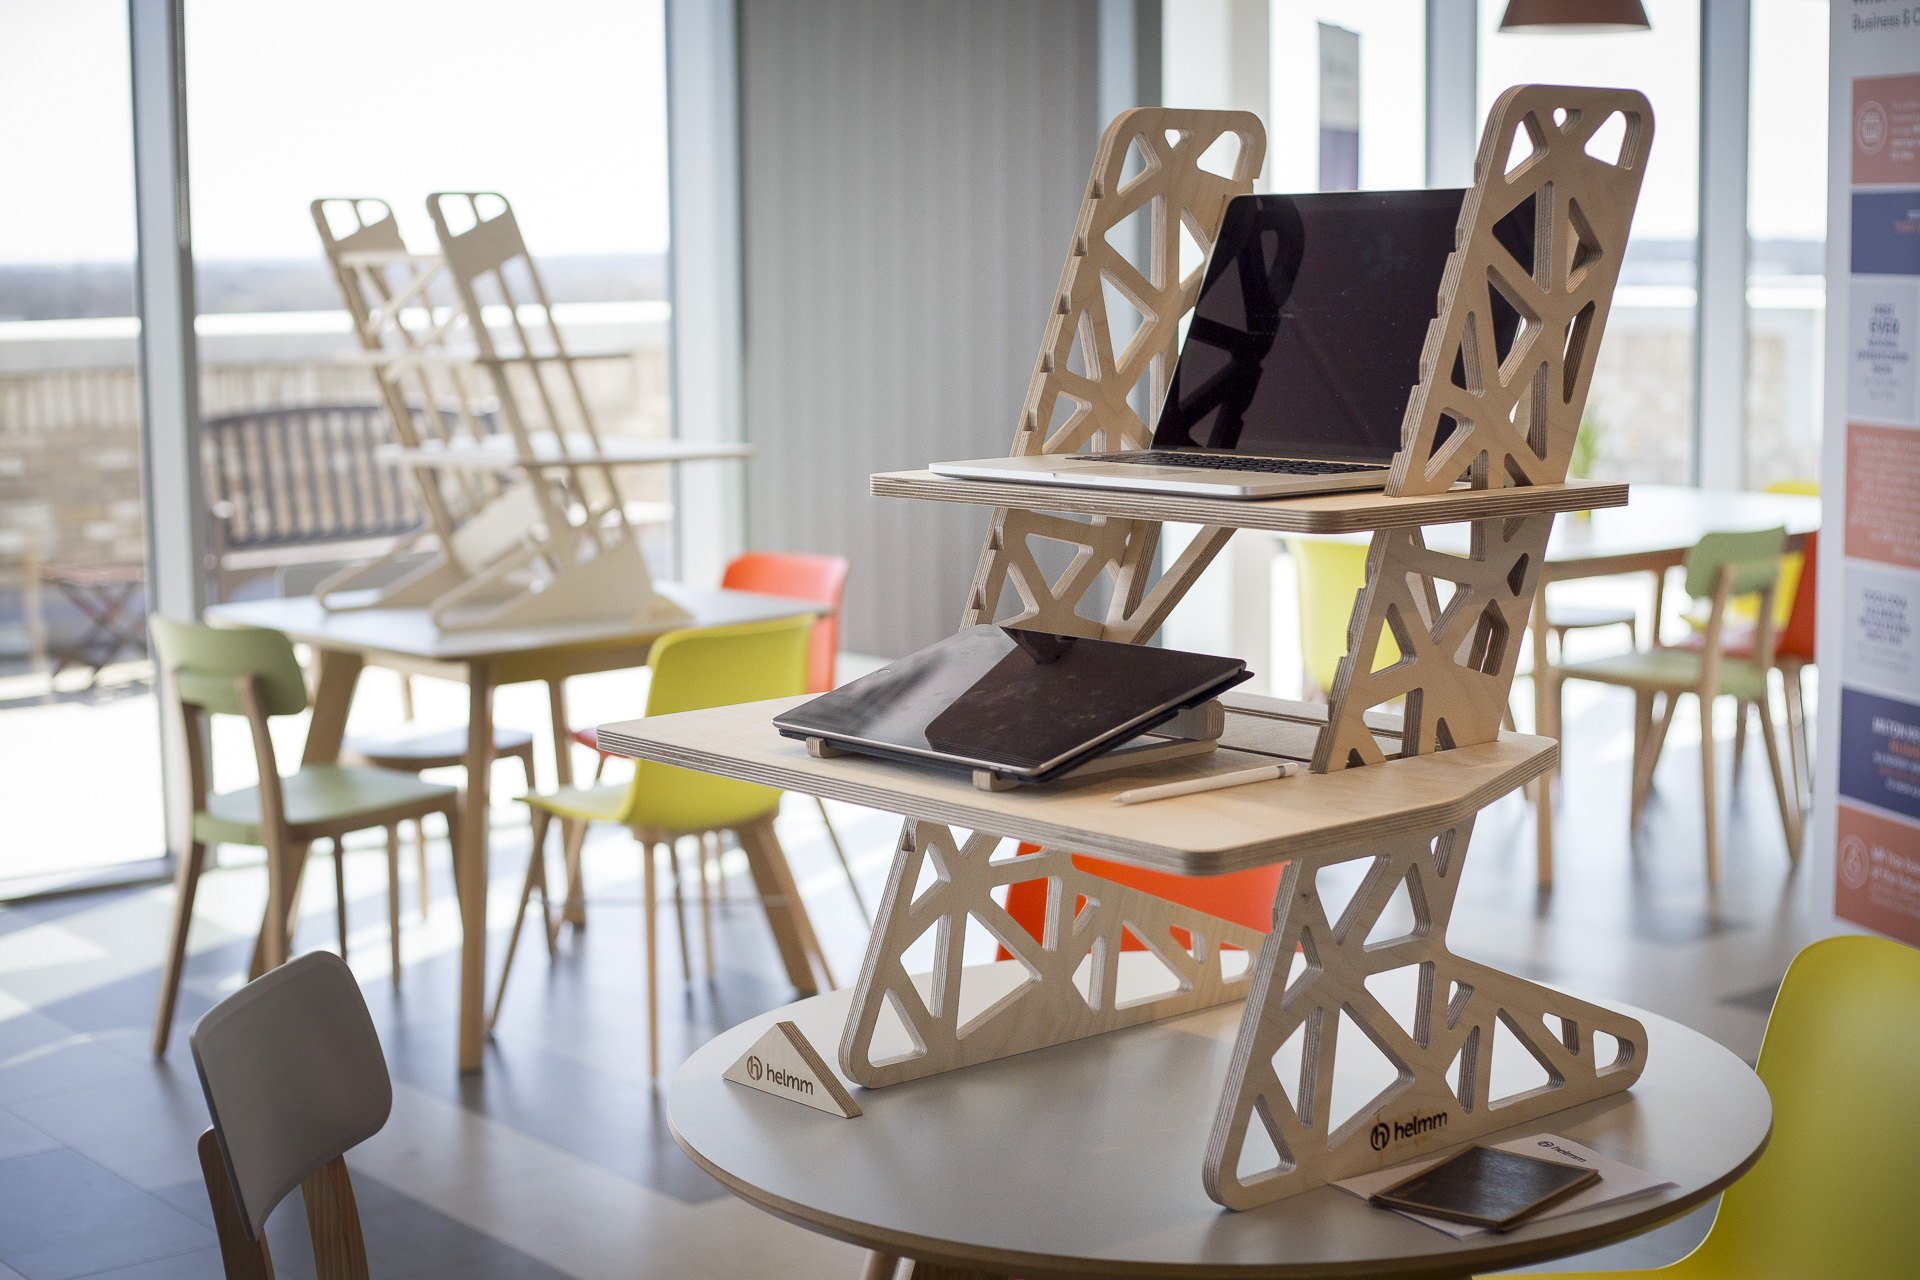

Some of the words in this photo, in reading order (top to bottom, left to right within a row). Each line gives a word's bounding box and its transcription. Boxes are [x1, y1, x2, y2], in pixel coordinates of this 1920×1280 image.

[1852, 11, 1900, 33] Business
[766, 1063, 814, 1096] helmm
[1394, 1112, 1448, 1141] helmm
